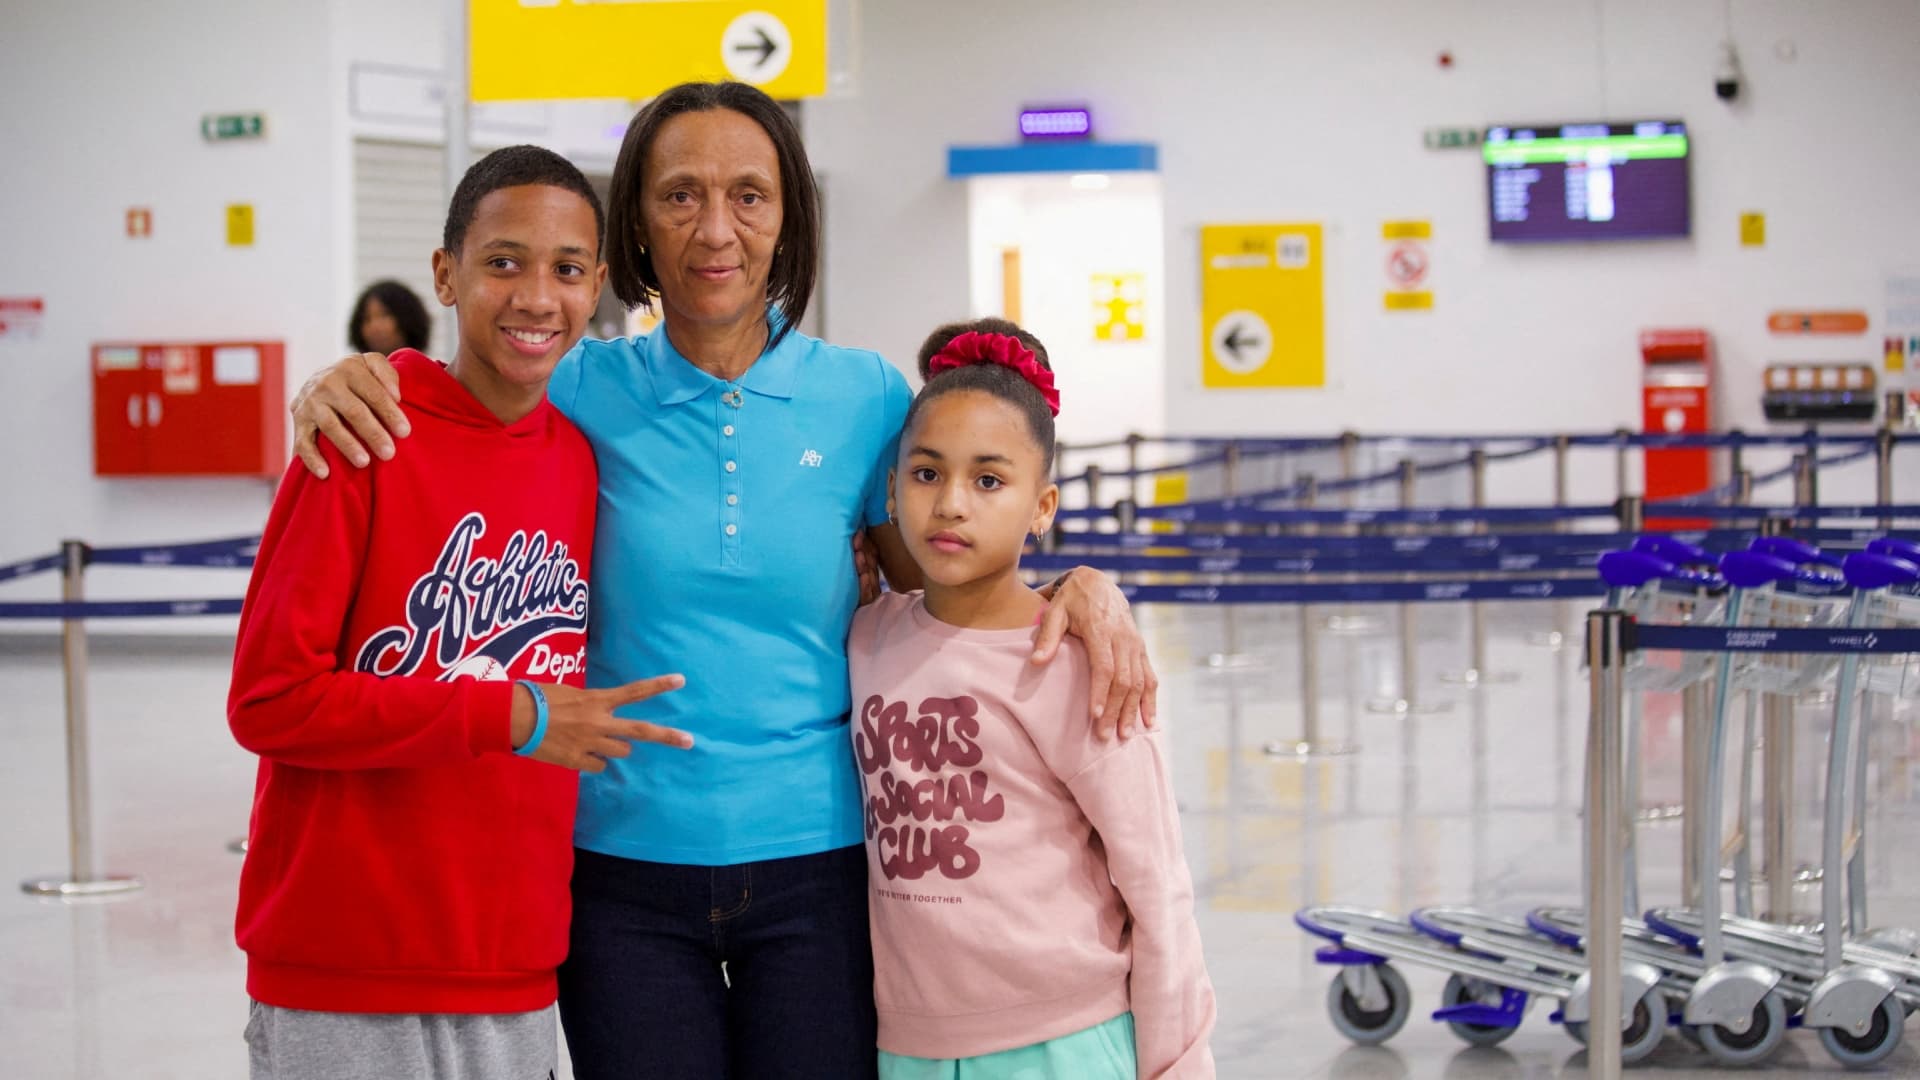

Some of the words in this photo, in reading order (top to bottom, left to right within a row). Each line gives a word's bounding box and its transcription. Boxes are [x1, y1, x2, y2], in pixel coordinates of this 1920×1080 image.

[856, 694, 983, 775] SPORTS
[877, 770, 1005, 823] SOCIAL
[878, 825, 981, 880] CLUB
[913, 894, 963, 904] TOGETHER
